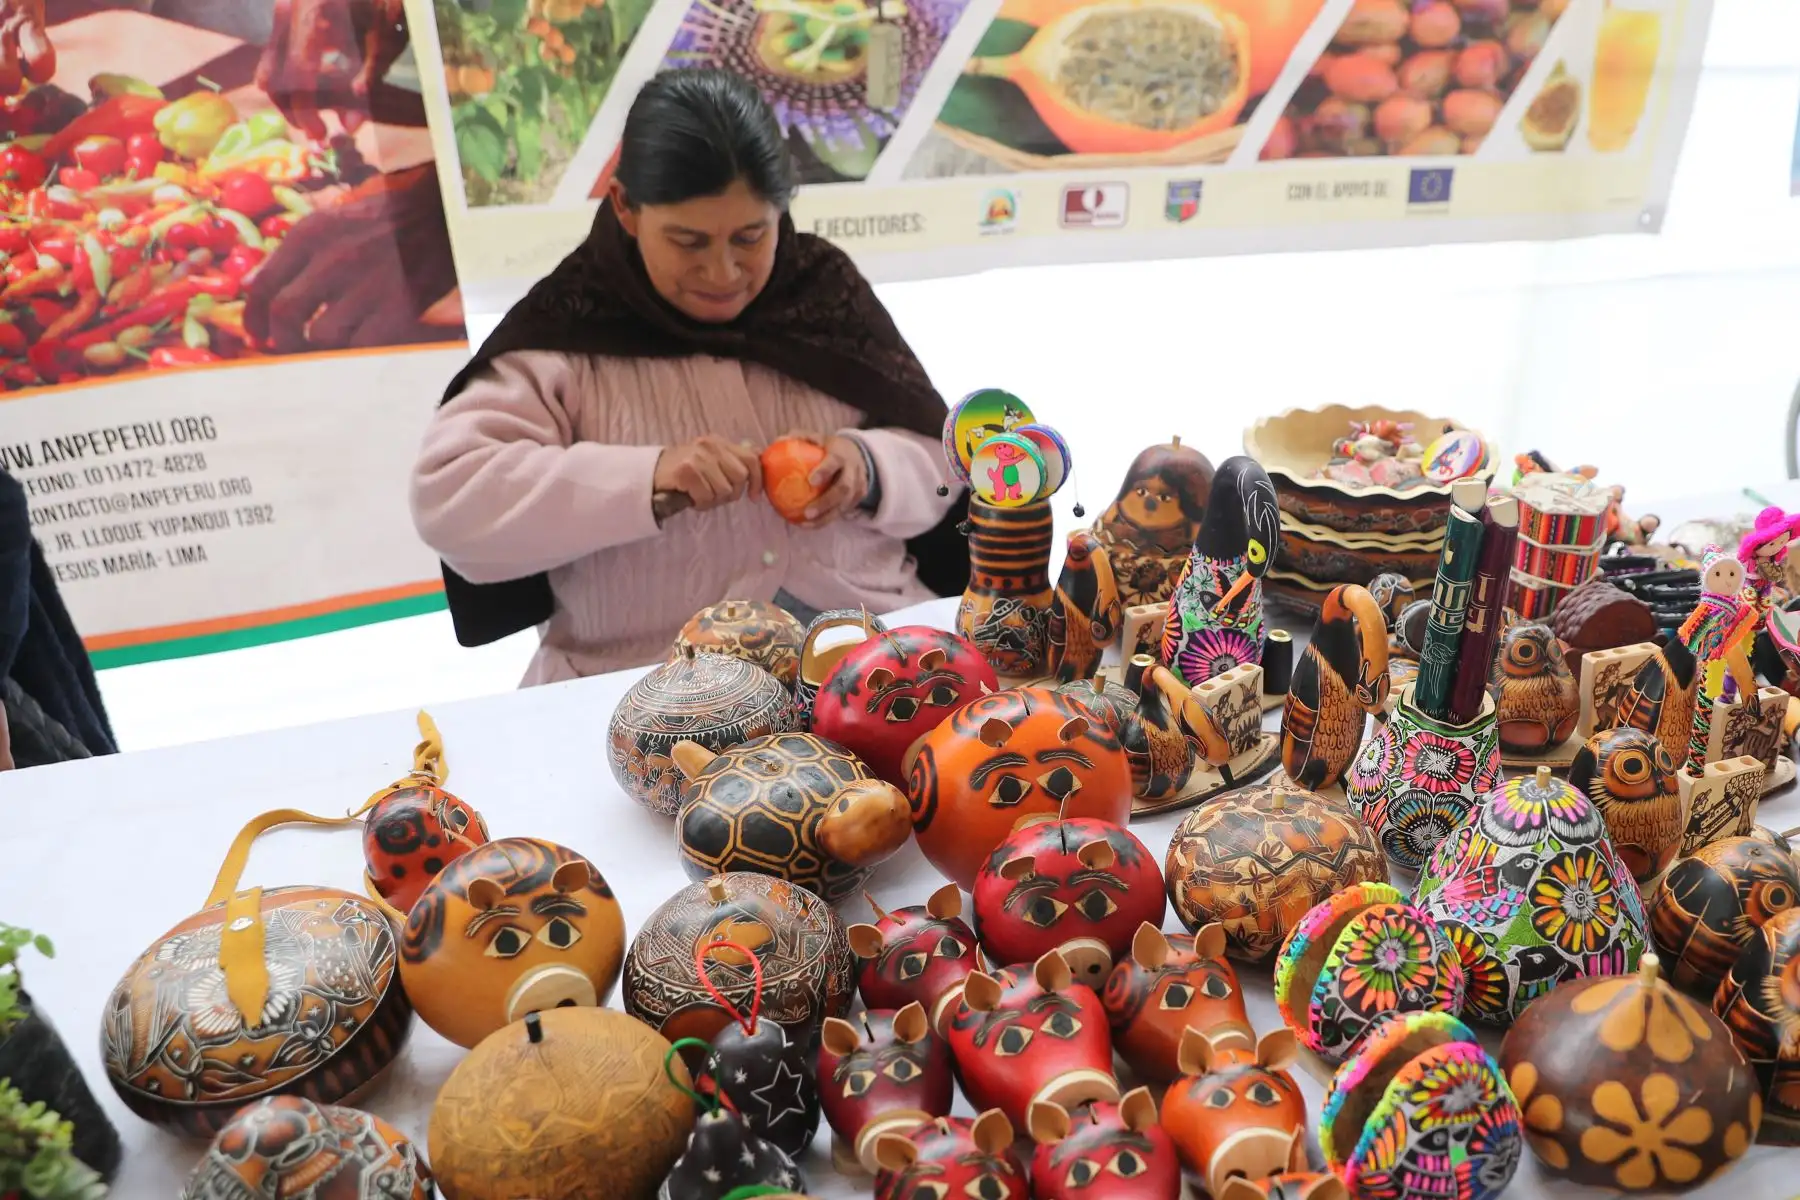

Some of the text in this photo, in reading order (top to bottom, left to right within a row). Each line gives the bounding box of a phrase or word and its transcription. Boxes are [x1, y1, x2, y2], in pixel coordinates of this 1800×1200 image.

[26, 471, 81, 496] FONO:
[30, 477, 252, 526] ONTACTO@ANPEPERU.ORG
[82, 522, 145, 547] LLOQUE
[147, 510, 230, 537] YUPANQUI
[55, 559, 99, 582] ESUS
[165, 544, 208, 567] LIMA
